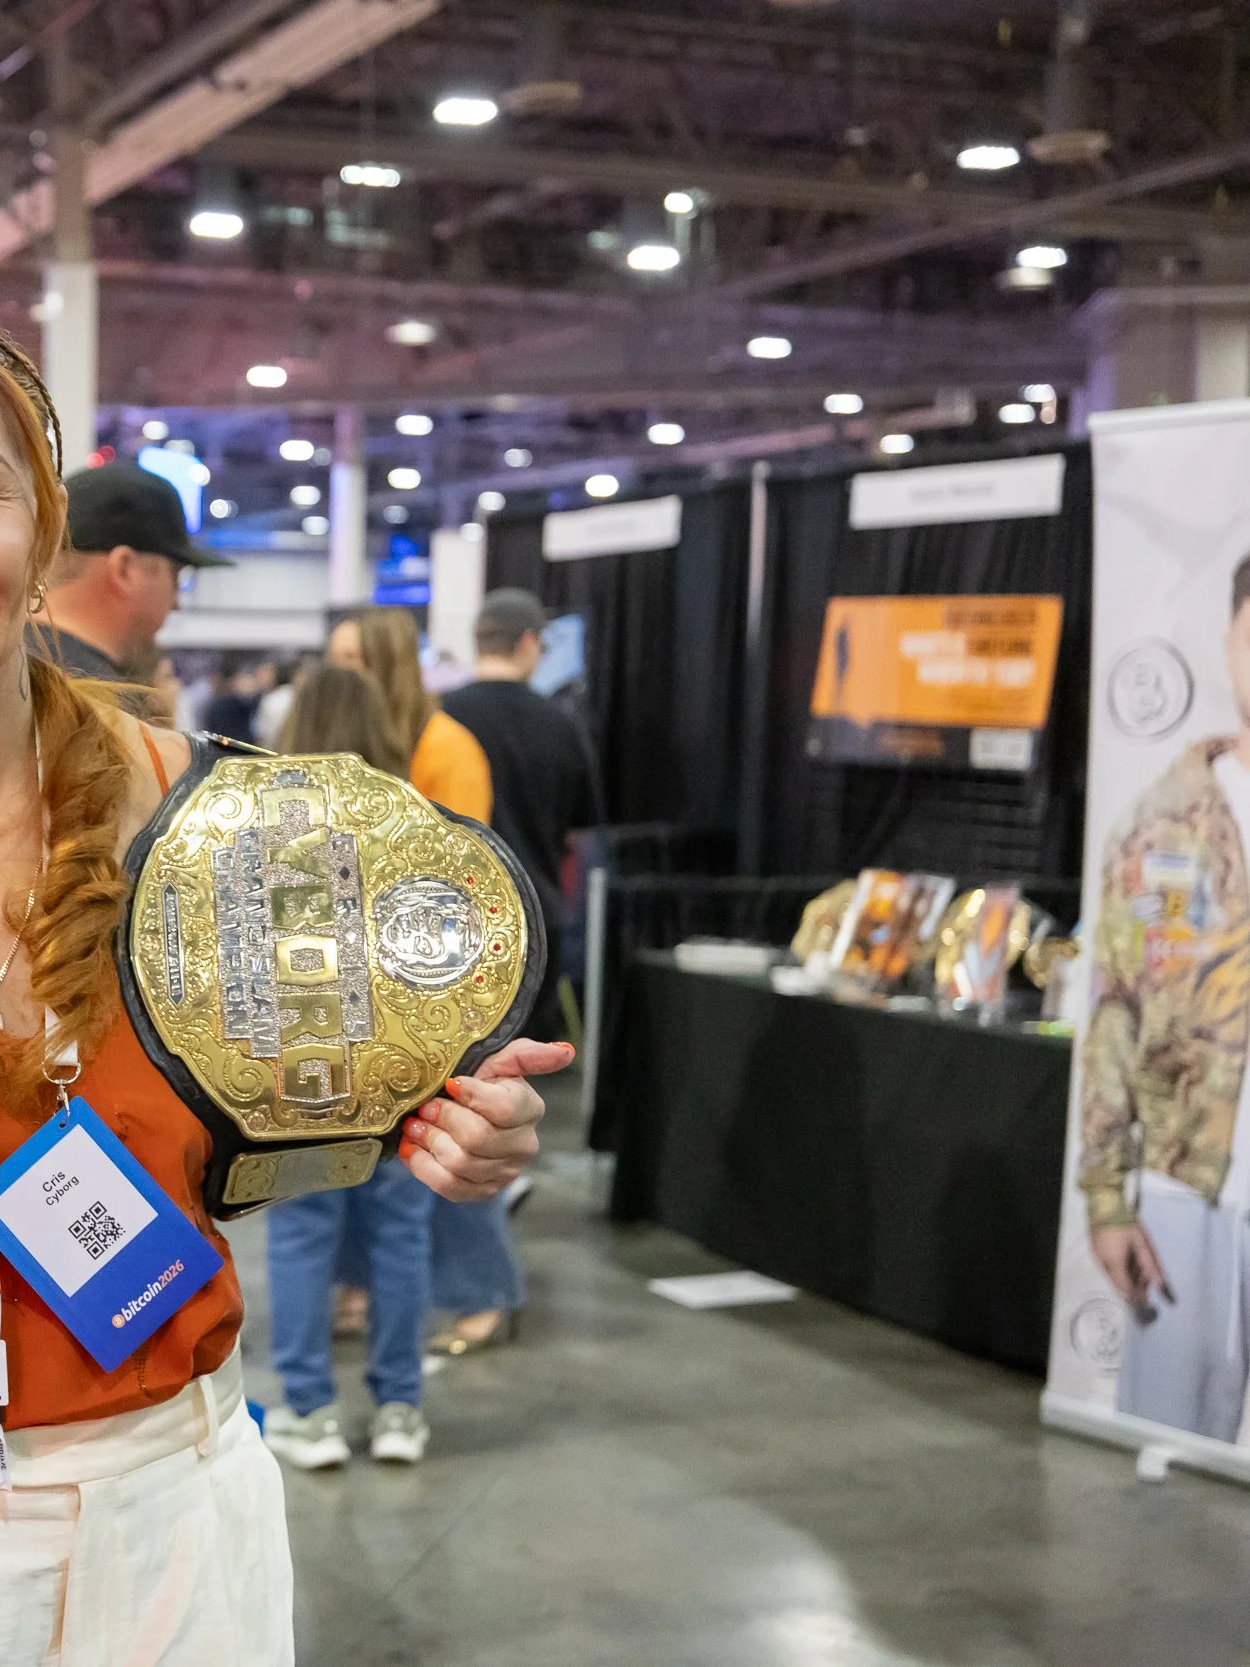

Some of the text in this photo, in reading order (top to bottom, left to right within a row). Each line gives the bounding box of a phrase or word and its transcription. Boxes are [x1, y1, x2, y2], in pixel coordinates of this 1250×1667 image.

[261, 786, 349, 1099] CYBORG
[250, 956, 278, 1058] SLAM
[41, 1169, 67, 1194] Cris
[45, 1175, 80, 1207] Cyborg
[122, 1259, 185, 1323] bitcoin2026
